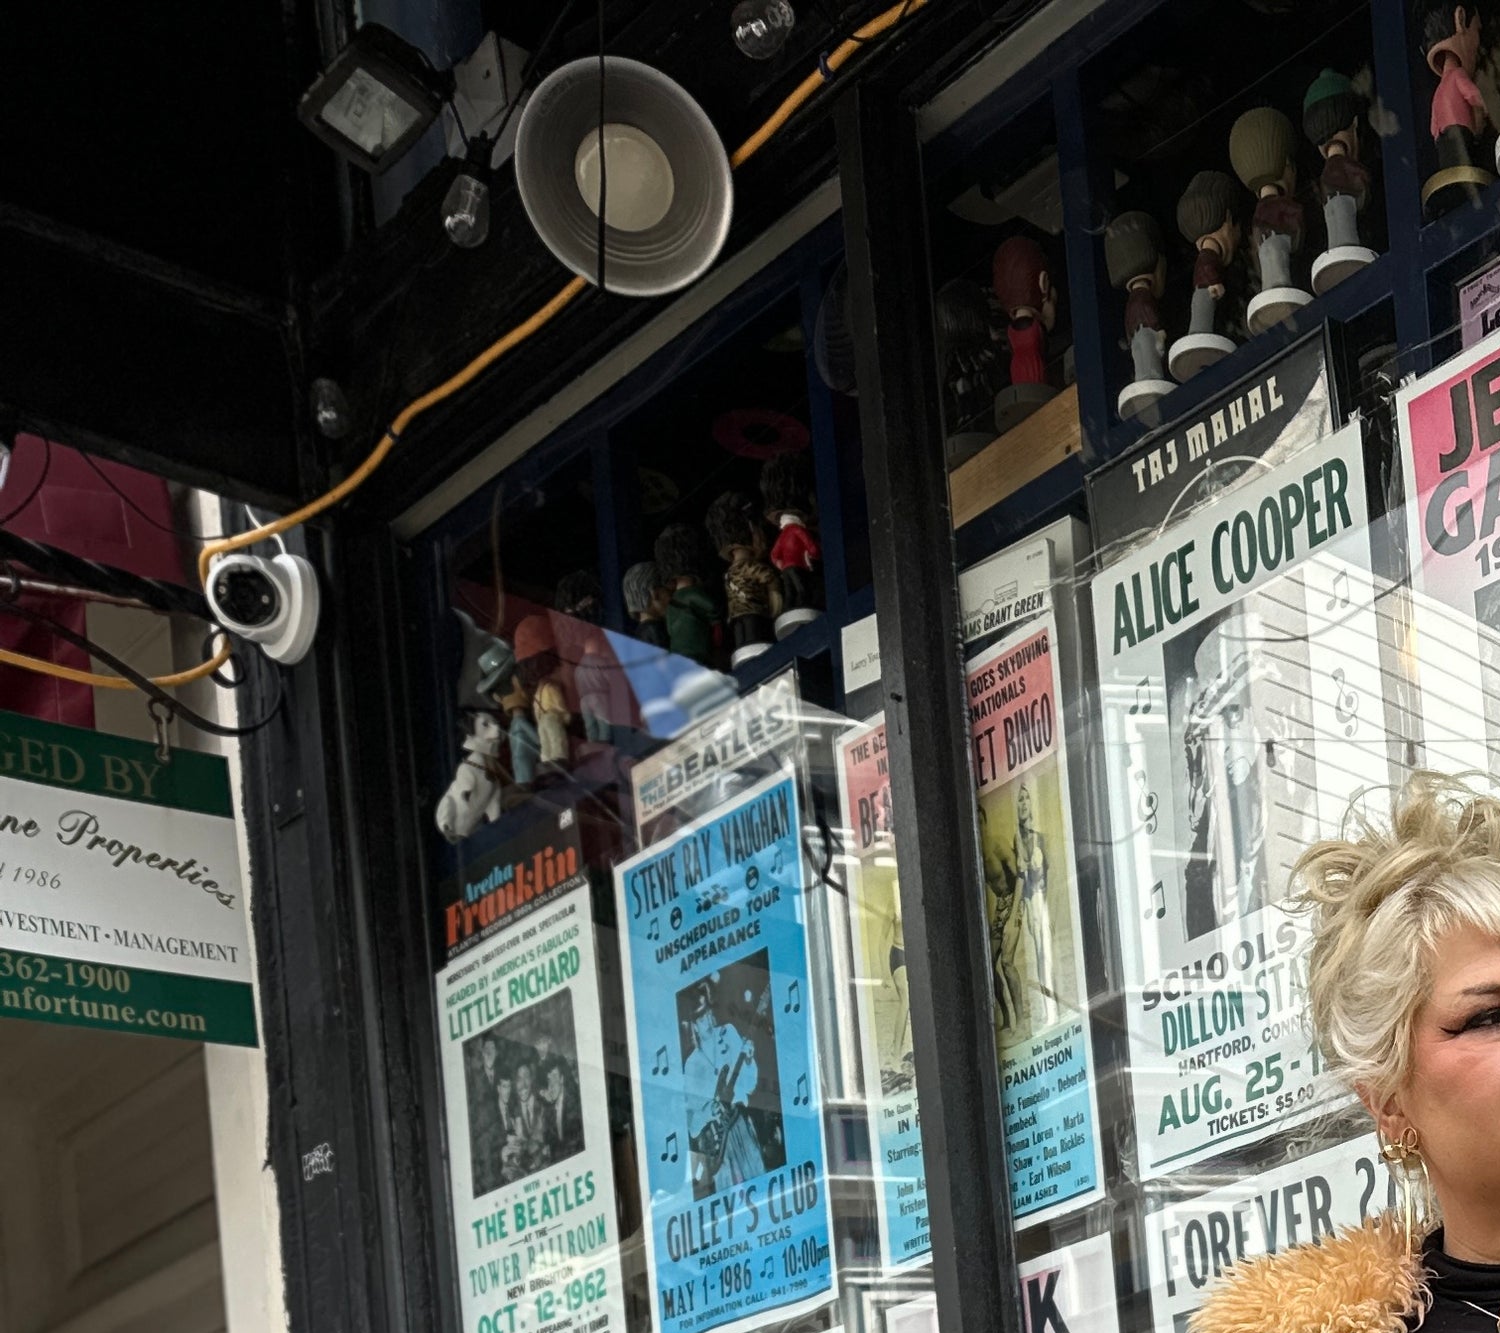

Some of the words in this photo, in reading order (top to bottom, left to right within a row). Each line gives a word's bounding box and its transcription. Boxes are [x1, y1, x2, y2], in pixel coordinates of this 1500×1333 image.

[1132, 439, 1178, 493] TAJ
[1187, 380, 1283, 461] MAHAL
[1113, 540, 1199, 656] ALICE
[1212, 458, 1352, 595] COOPER
[1005, 693, 1053, 772] BINGO
[102, 754, 161, 799] BY
[12, 866, 62, 890] 1986
[57, 809, 234, 911] Properties
[464, 863, 513, 903] Aretha
[630, 859, 678, 920] STEVIE
[683, 830, 712, 890] RAY
[721, 787, 791, 867] VAUGHAN
[446, 845, 579, 948] Franklin
[655, 910, 741, 964] UNSCHEDULED
[746, 886, 780, 920] TOUR
[114, 929, 238, 964] MANAGEMENT
[448, 988, 502, 1041] LITTLE
[509, 946, 580, 1009] RICHARD
[1162, 990, 1245, 1056] DILLON
[1006, 1047, 1073, 1091] PANAVISION
[1158, 1077, 1232, 1135] AUG.
[1246, 1052, 1283, 1102] 25
[1207, 1105, 1269, 1137] TICKETS:
[472, 1215, 506, 1249] THE
[515, 1172, 595, 1233] BEATLES
[667, 1184, 759, 1263] GILLEY'S
[769, 1161, 817, 1224] CLUB
[758, 1228, 791, 1248] TEXAS
[469, 1251, 520, 1296] TOWER
[528, 1215, 606, 1273] BALLROOM
[663, 1282, 694, 1321] MAY
